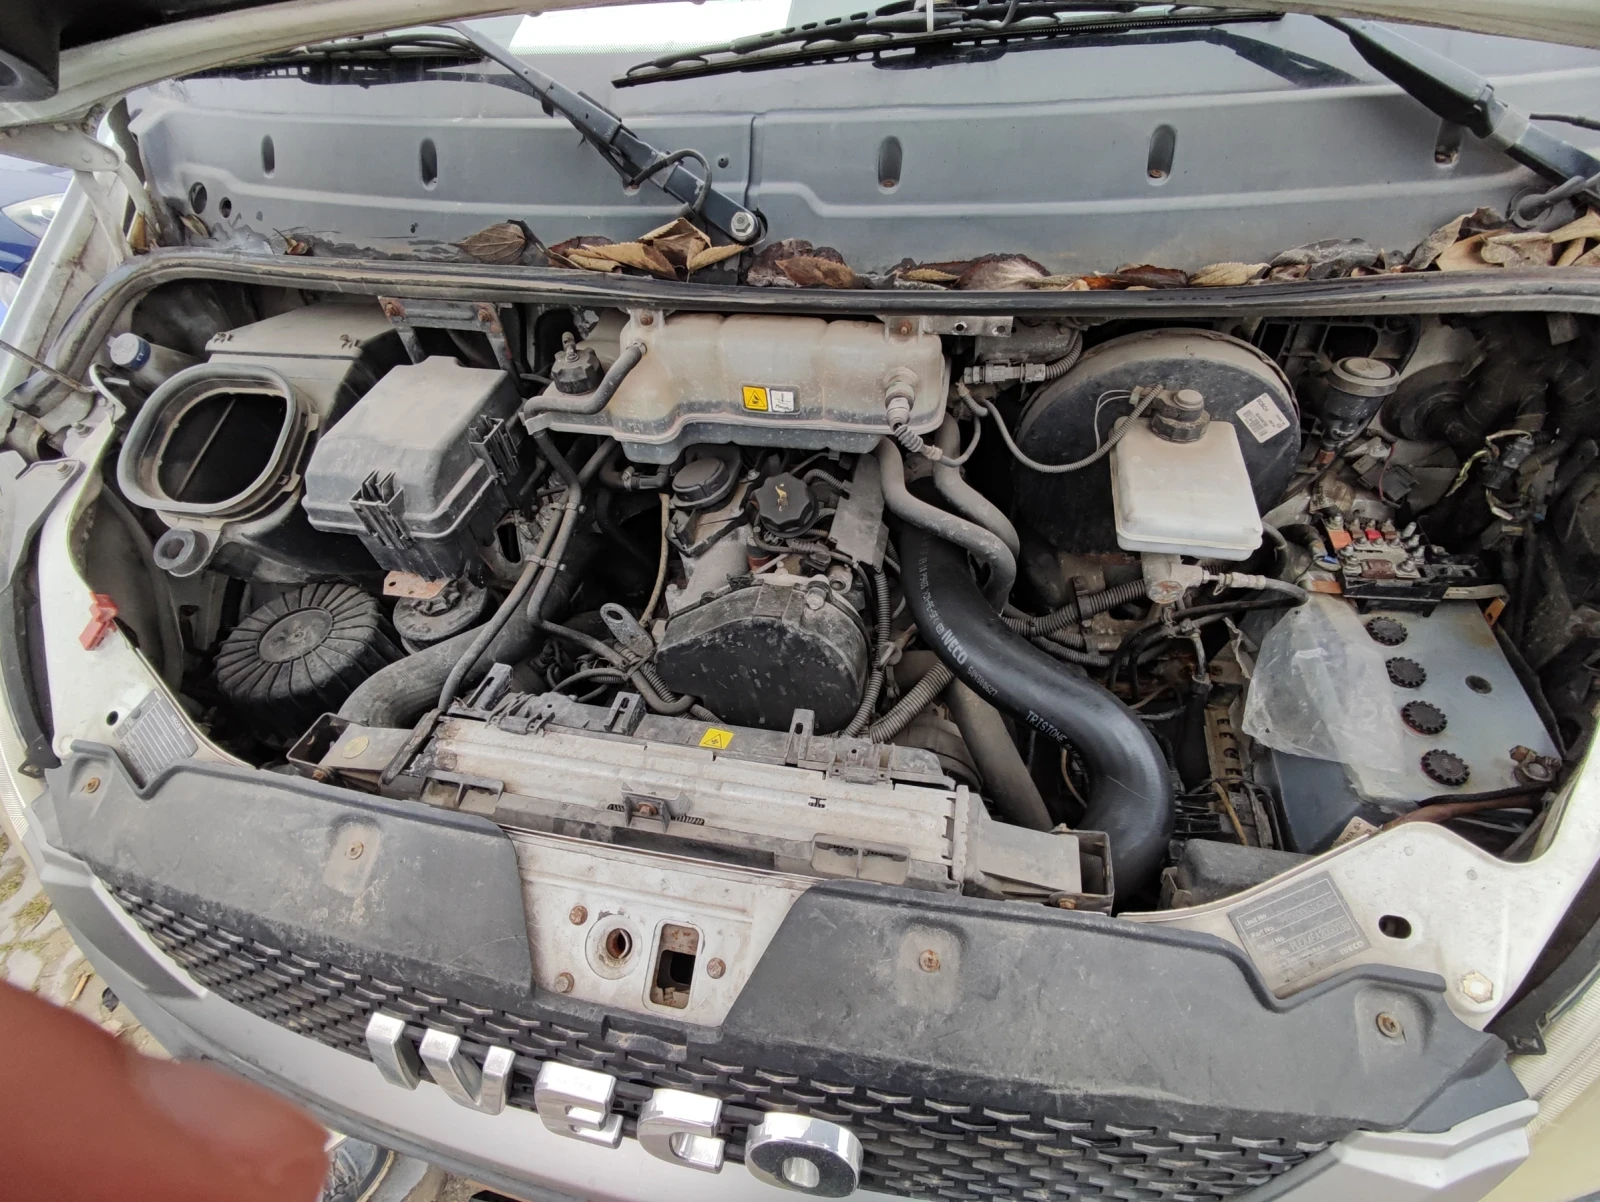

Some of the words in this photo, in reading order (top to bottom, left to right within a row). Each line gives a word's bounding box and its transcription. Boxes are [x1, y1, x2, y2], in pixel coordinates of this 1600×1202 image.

[941, 628, 969, 665] IVECO
[1025, 710, 1069, 743] TRISTONE
[1244, 917, 1258, 927] Unit
[1258, 913, 1267, 921] No
[1250, 928, 1265, 938] Part
[1275, 936, 1285, 944] No
[1339, 941, 1364, 955] IVECO
[364, 1011, 865, 1198] IVECO
